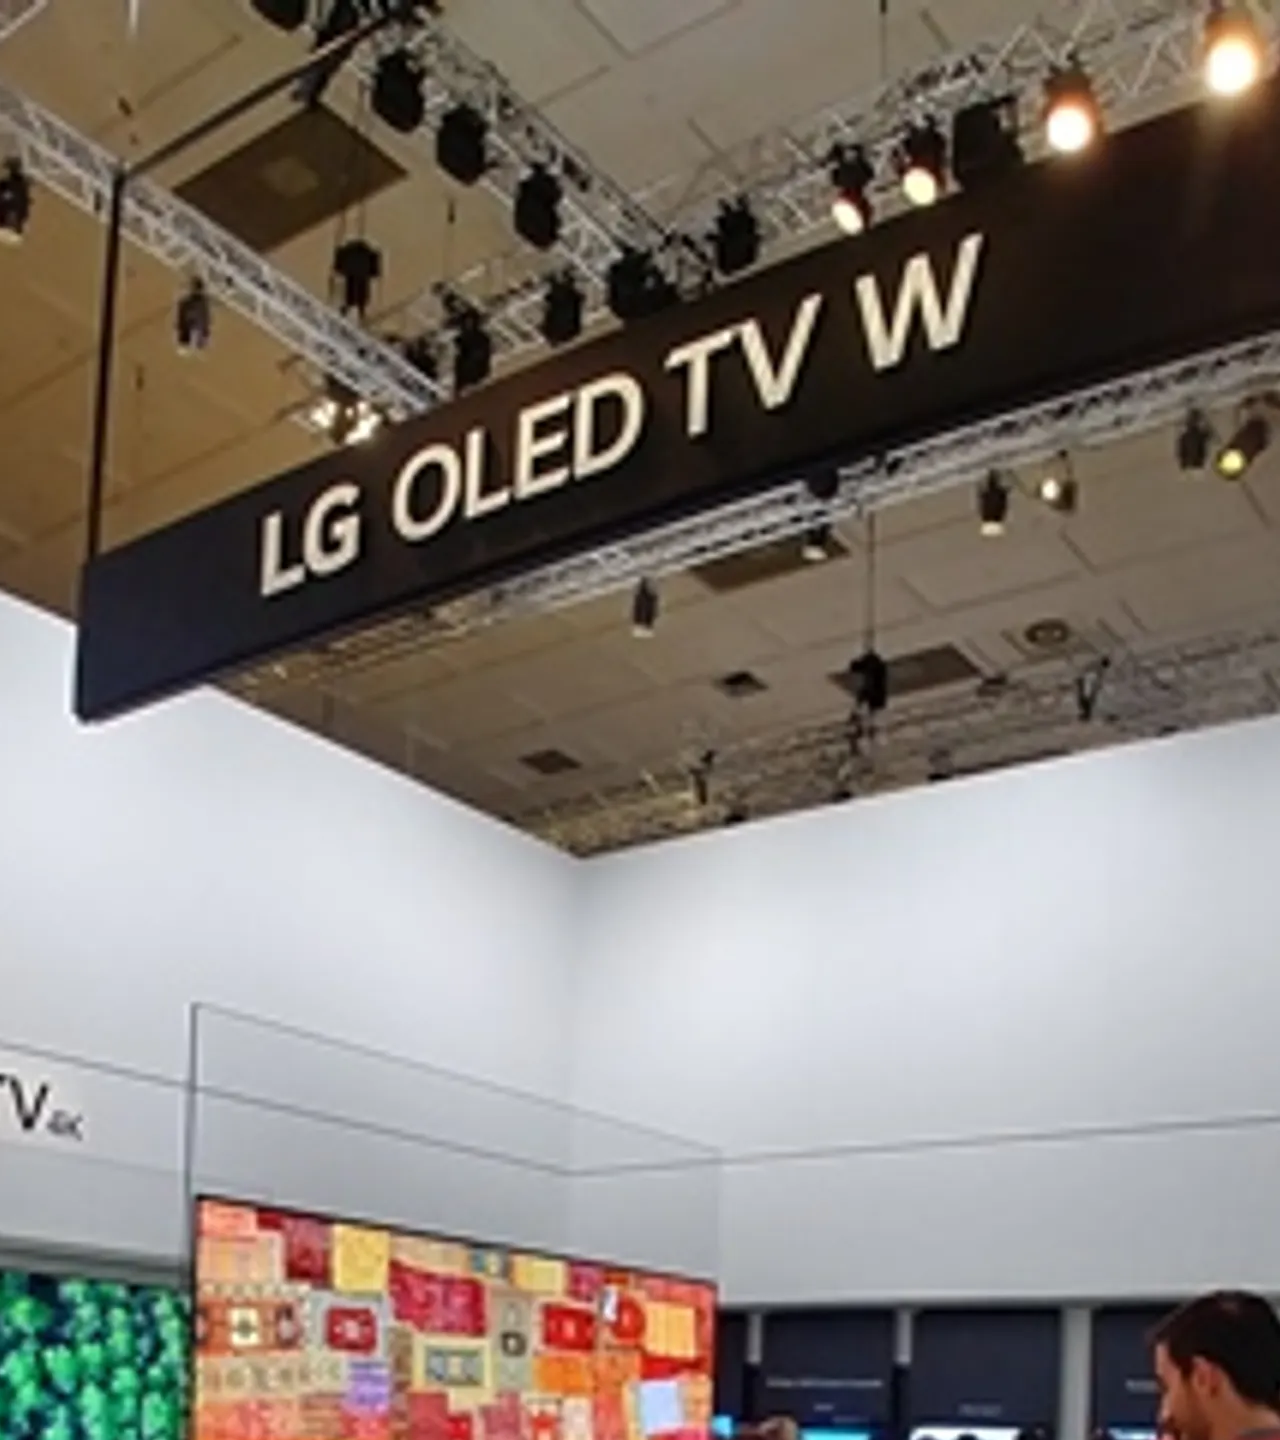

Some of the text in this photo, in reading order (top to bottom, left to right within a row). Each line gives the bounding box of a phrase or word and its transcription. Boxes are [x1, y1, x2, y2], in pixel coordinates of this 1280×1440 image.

[260, 231, 985, 598] LG OLED TV W
